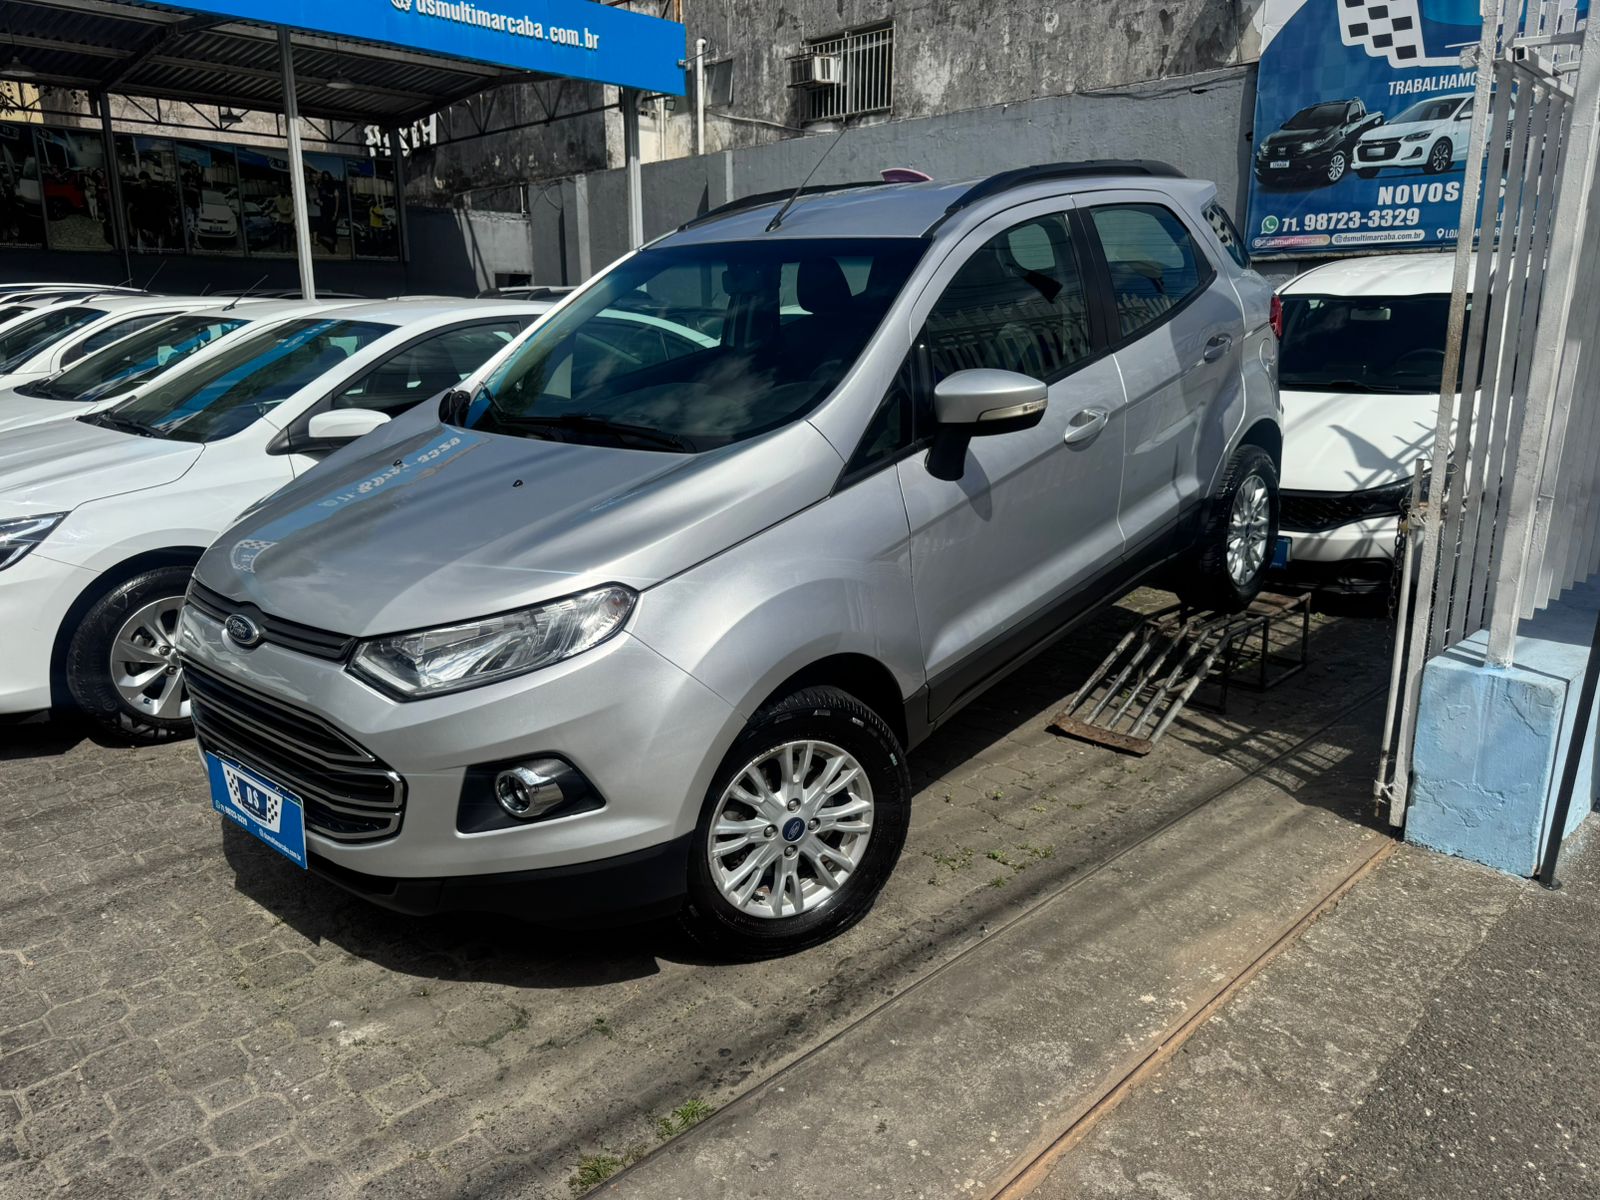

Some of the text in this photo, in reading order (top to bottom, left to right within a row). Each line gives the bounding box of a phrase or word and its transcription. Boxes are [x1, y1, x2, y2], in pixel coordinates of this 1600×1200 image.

[1388, 72, 1477, 96] TRABALHAMO
[1377, 181, 1460, 206] NOVOS
[1282, 208, 1420, 232] 71. 98723-3329
